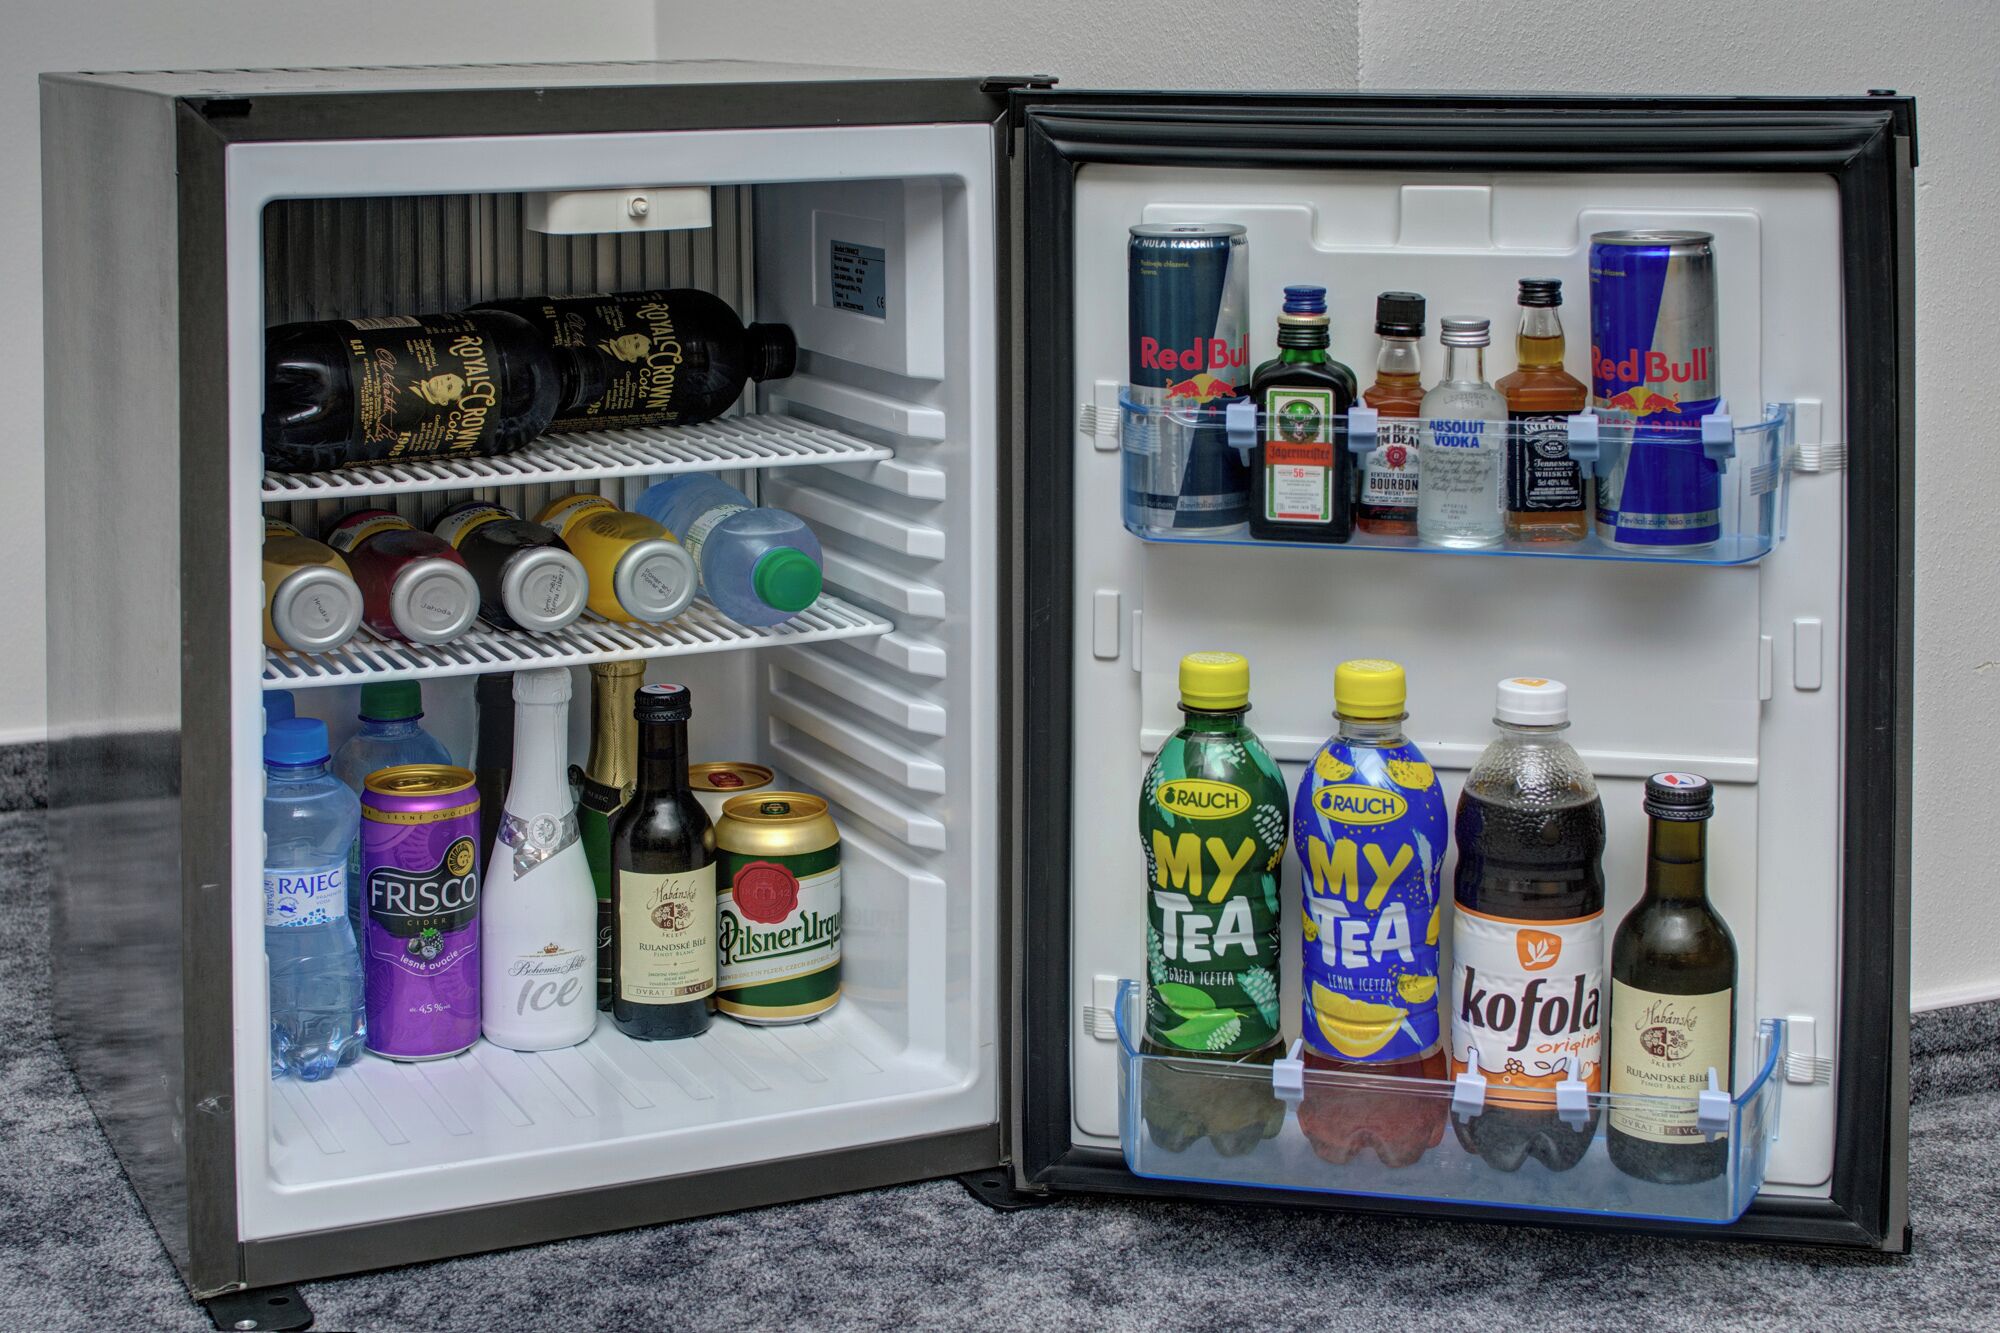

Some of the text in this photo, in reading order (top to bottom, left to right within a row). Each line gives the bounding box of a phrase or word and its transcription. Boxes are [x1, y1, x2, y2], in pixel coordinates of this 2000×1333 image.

[1142, 239, 1167, 249] NULA
[636, 303, 676, 346] ROYAL
[449, 336, 490, 387] ROYAL
[1141, 336, 1202, 371] Red
[1591, 344, 1708, 383] Red Bull
[638, 368, 651, 399] Cola
[646, 341, 683, 409] CROWN
[449, 381, 496, 450] CROWN
[1598, 417, 1644, 432] NERGY
[445, 411, 462, 441] Cola
[1429, 419, 1486, 434] ABSOLUT
[389, 431, 413, 457] 1905
[1434, 435, 1480, 448] VODKA
[1293, 468, 1305, 479] 56
[1533, 459, 1574, 468] Tennessee
[1370, 478, 1419, 491] BOURBON
[420, 602, 452, 616] Jahoda
[1176, 789, 1239, 809] RAUCH
[1333, 795, 1395, 815] RAUCH
[1152, 829, 1256, 904] MY
[1308, 834, 1415, 910] MY
[278, 870, 340, 898] RAJEC
[646, 878, 697, 910] Habánské
[371, 873, 477, 916] FRISCO
[407, 917, 446, 926] CIDER
[639, 935, 707, 952] RULANDSKÉ BÍLÉ
[719, 910, 840, 968] Pilsner Urqu
[400, 950, 459, 970] lesné ovocie
[508, 960, 561, 977] Bohemia
[1168, 967, 1235, 986] GREEN ICETEA
[1327, 973, 1393, 993] LEMON ICETEA
[636, 988, 666, 996] DVRAT
[418, 1003, 432, 1014] 4,5
[433, 1003, 443, 1012] %
[1461, 965, 1600, 1052] kofola
[1634, 999, 1698, 1032] Habánské
[1536, 1033, 1601, 1057] origina
[1653, 1045, 1680, 1058] 16 14
[1626, 1065, 1686, 1084] RULANDSKÉ
[1640, 1080, 1692, 1091] PINOT BLANC
